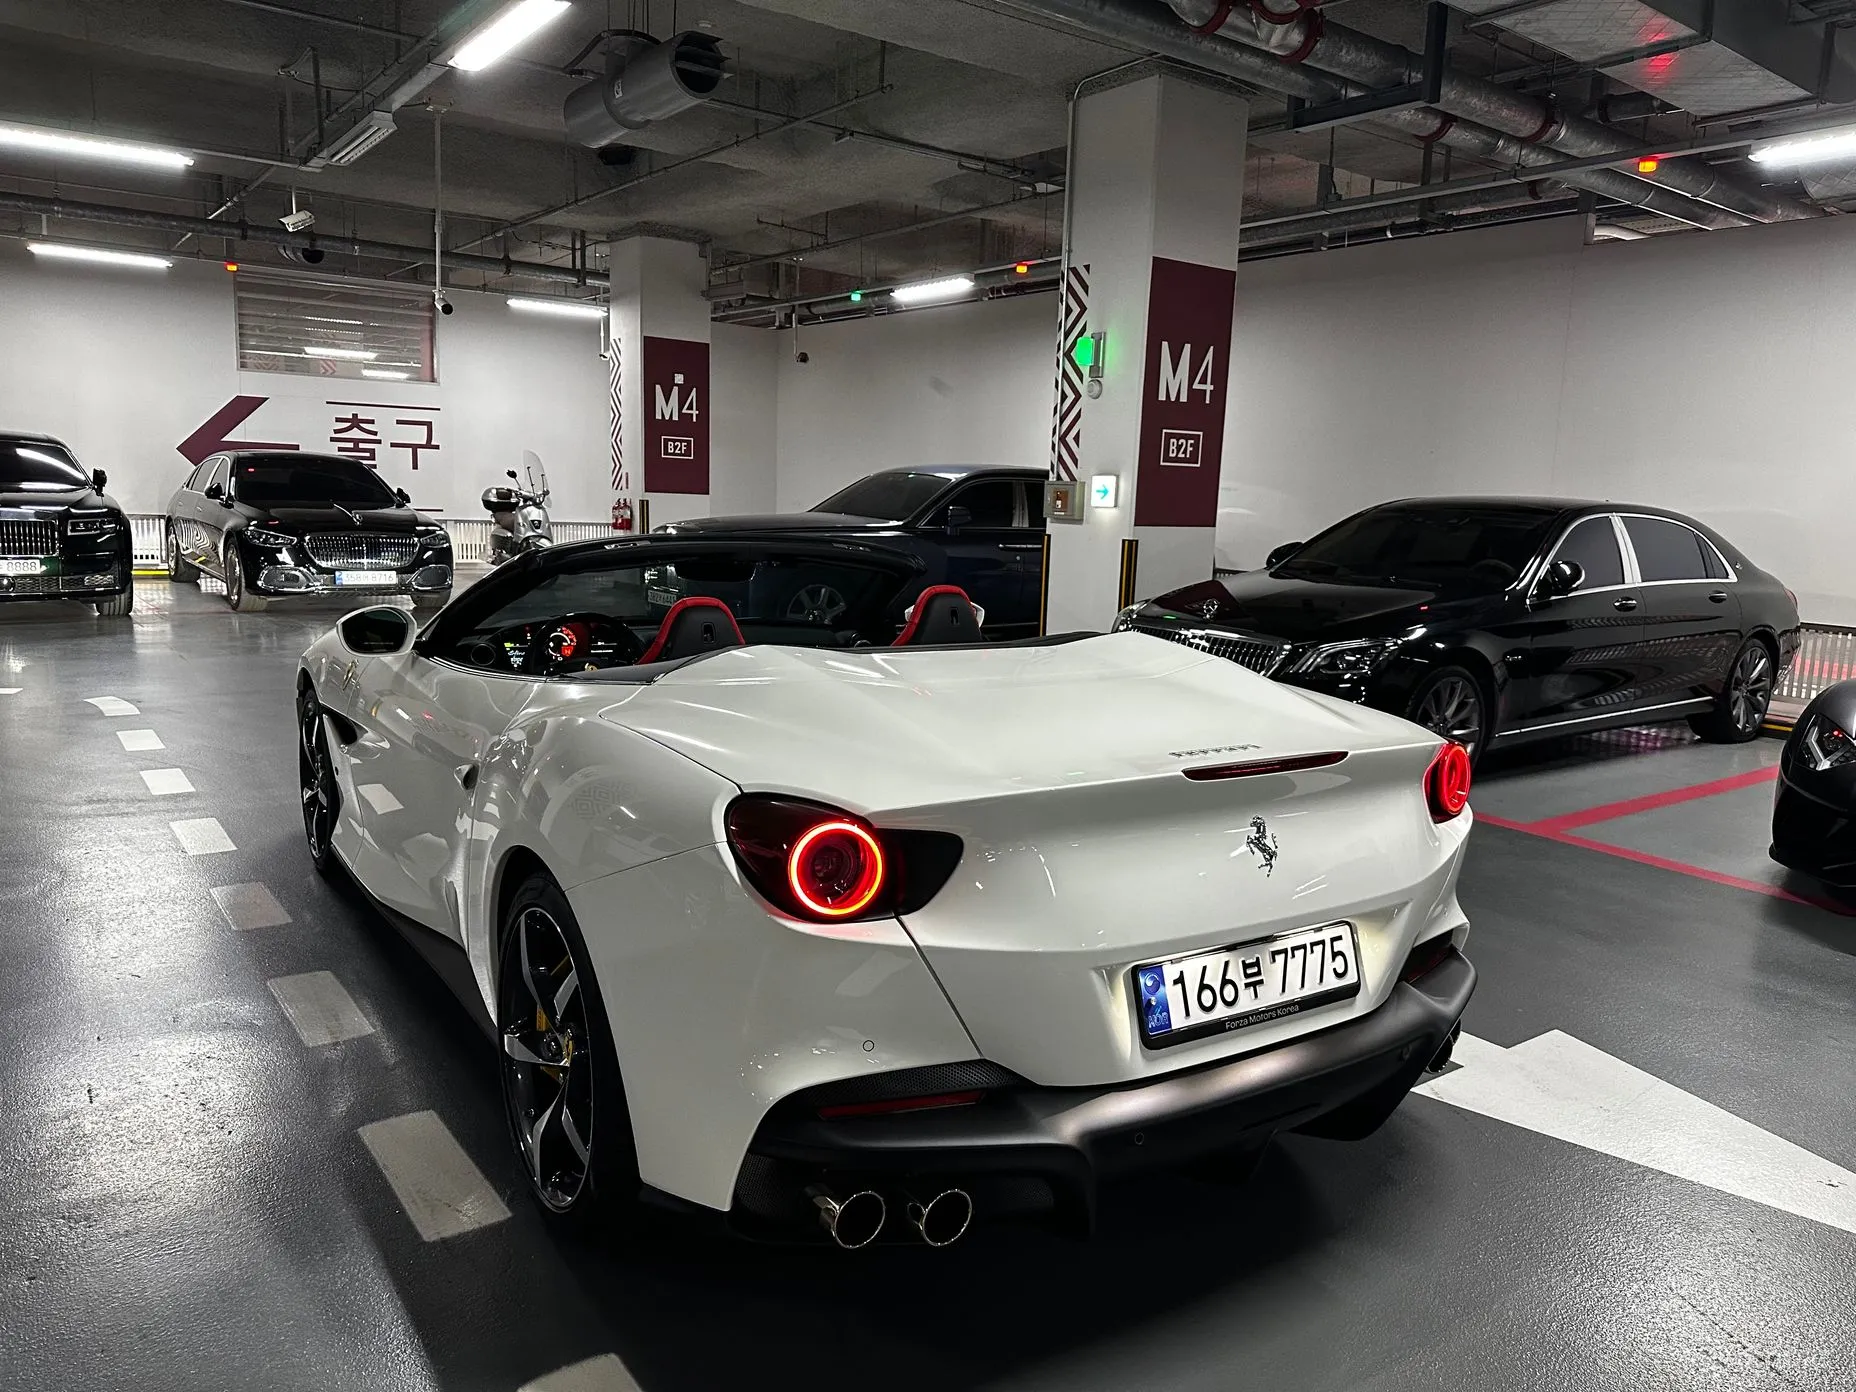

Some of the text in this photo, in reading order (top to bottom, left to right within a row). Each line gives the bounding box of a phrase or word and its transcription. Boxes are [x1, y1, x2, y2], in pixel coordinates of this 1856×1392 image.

[1158, 340, 1214, 404] M4
[655, 384, 699, 422] M4
[329, 413, 440, 470] 출구
[667, 441, 688, 454] B2F
[1168, 438, 1195, 458] B2F
[1225, 1004, 1300, 1030] Forza Motors Korea
